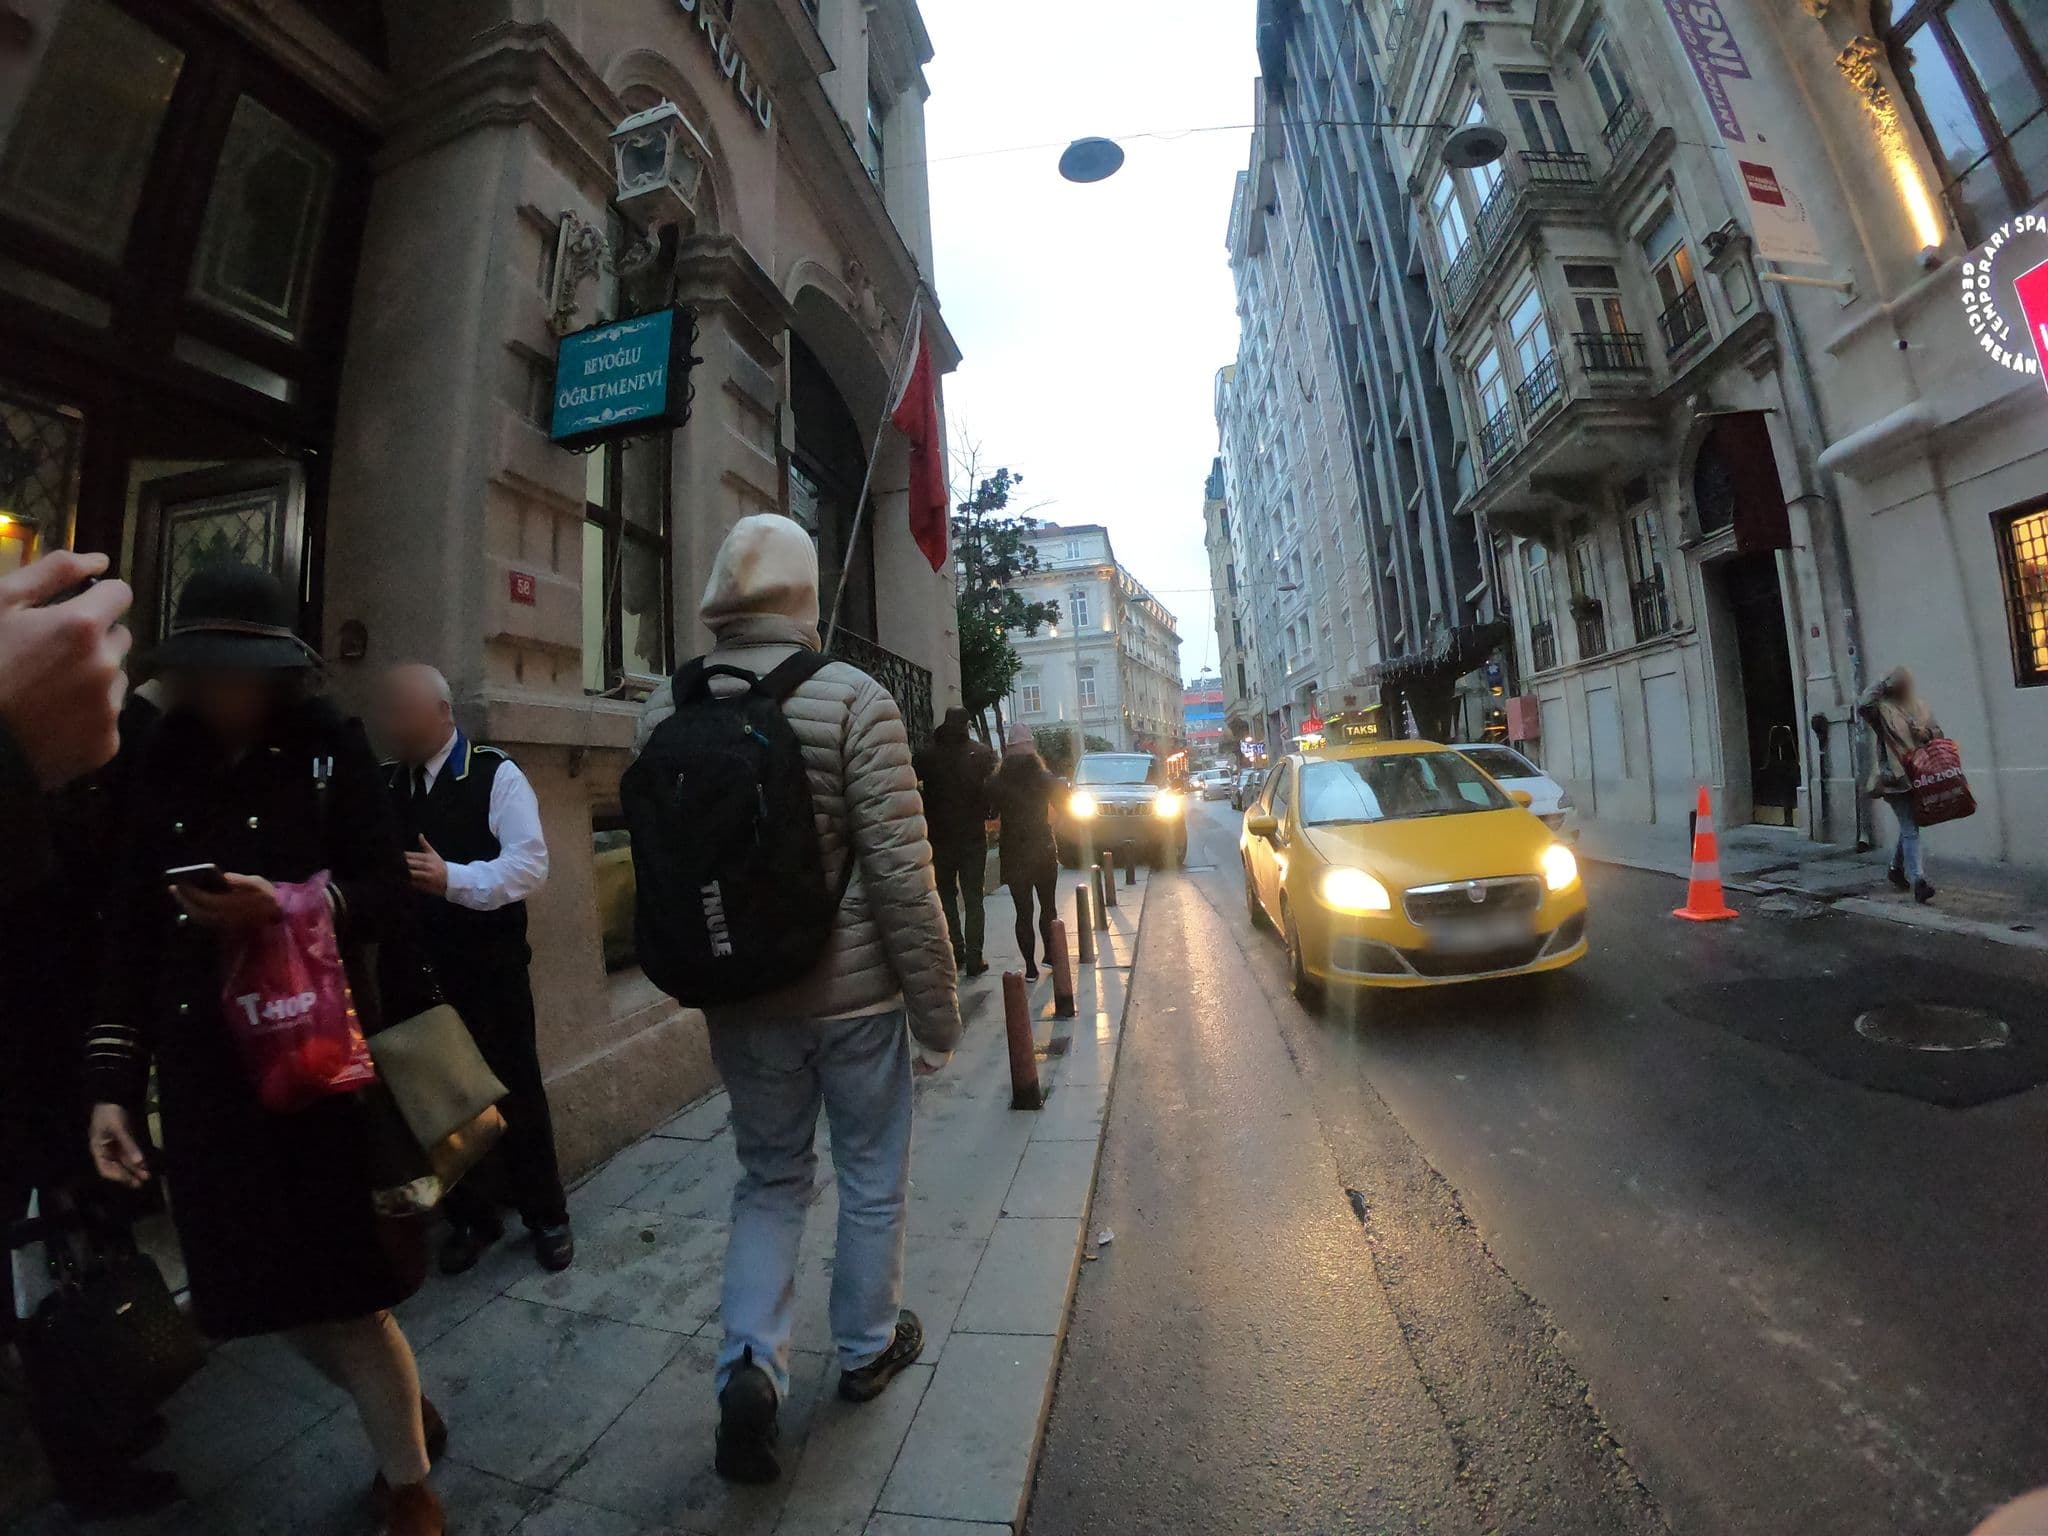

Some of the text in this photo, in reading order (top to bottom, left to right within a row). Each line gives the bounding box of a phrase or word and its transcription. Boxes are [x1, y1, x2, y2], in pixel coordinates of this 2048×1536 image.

[680, 0, 772, 129] KULU
[1688, 0, 1745, 71] INS
[1691, 48, 1738, 136] ANTHONY
[2015, 214, 2048, 234] SPA
[583, 346, 642, 376] BEYOĞLU
[517, 579, 530, 596] 58
[700, 879, 733, 957] THULE
